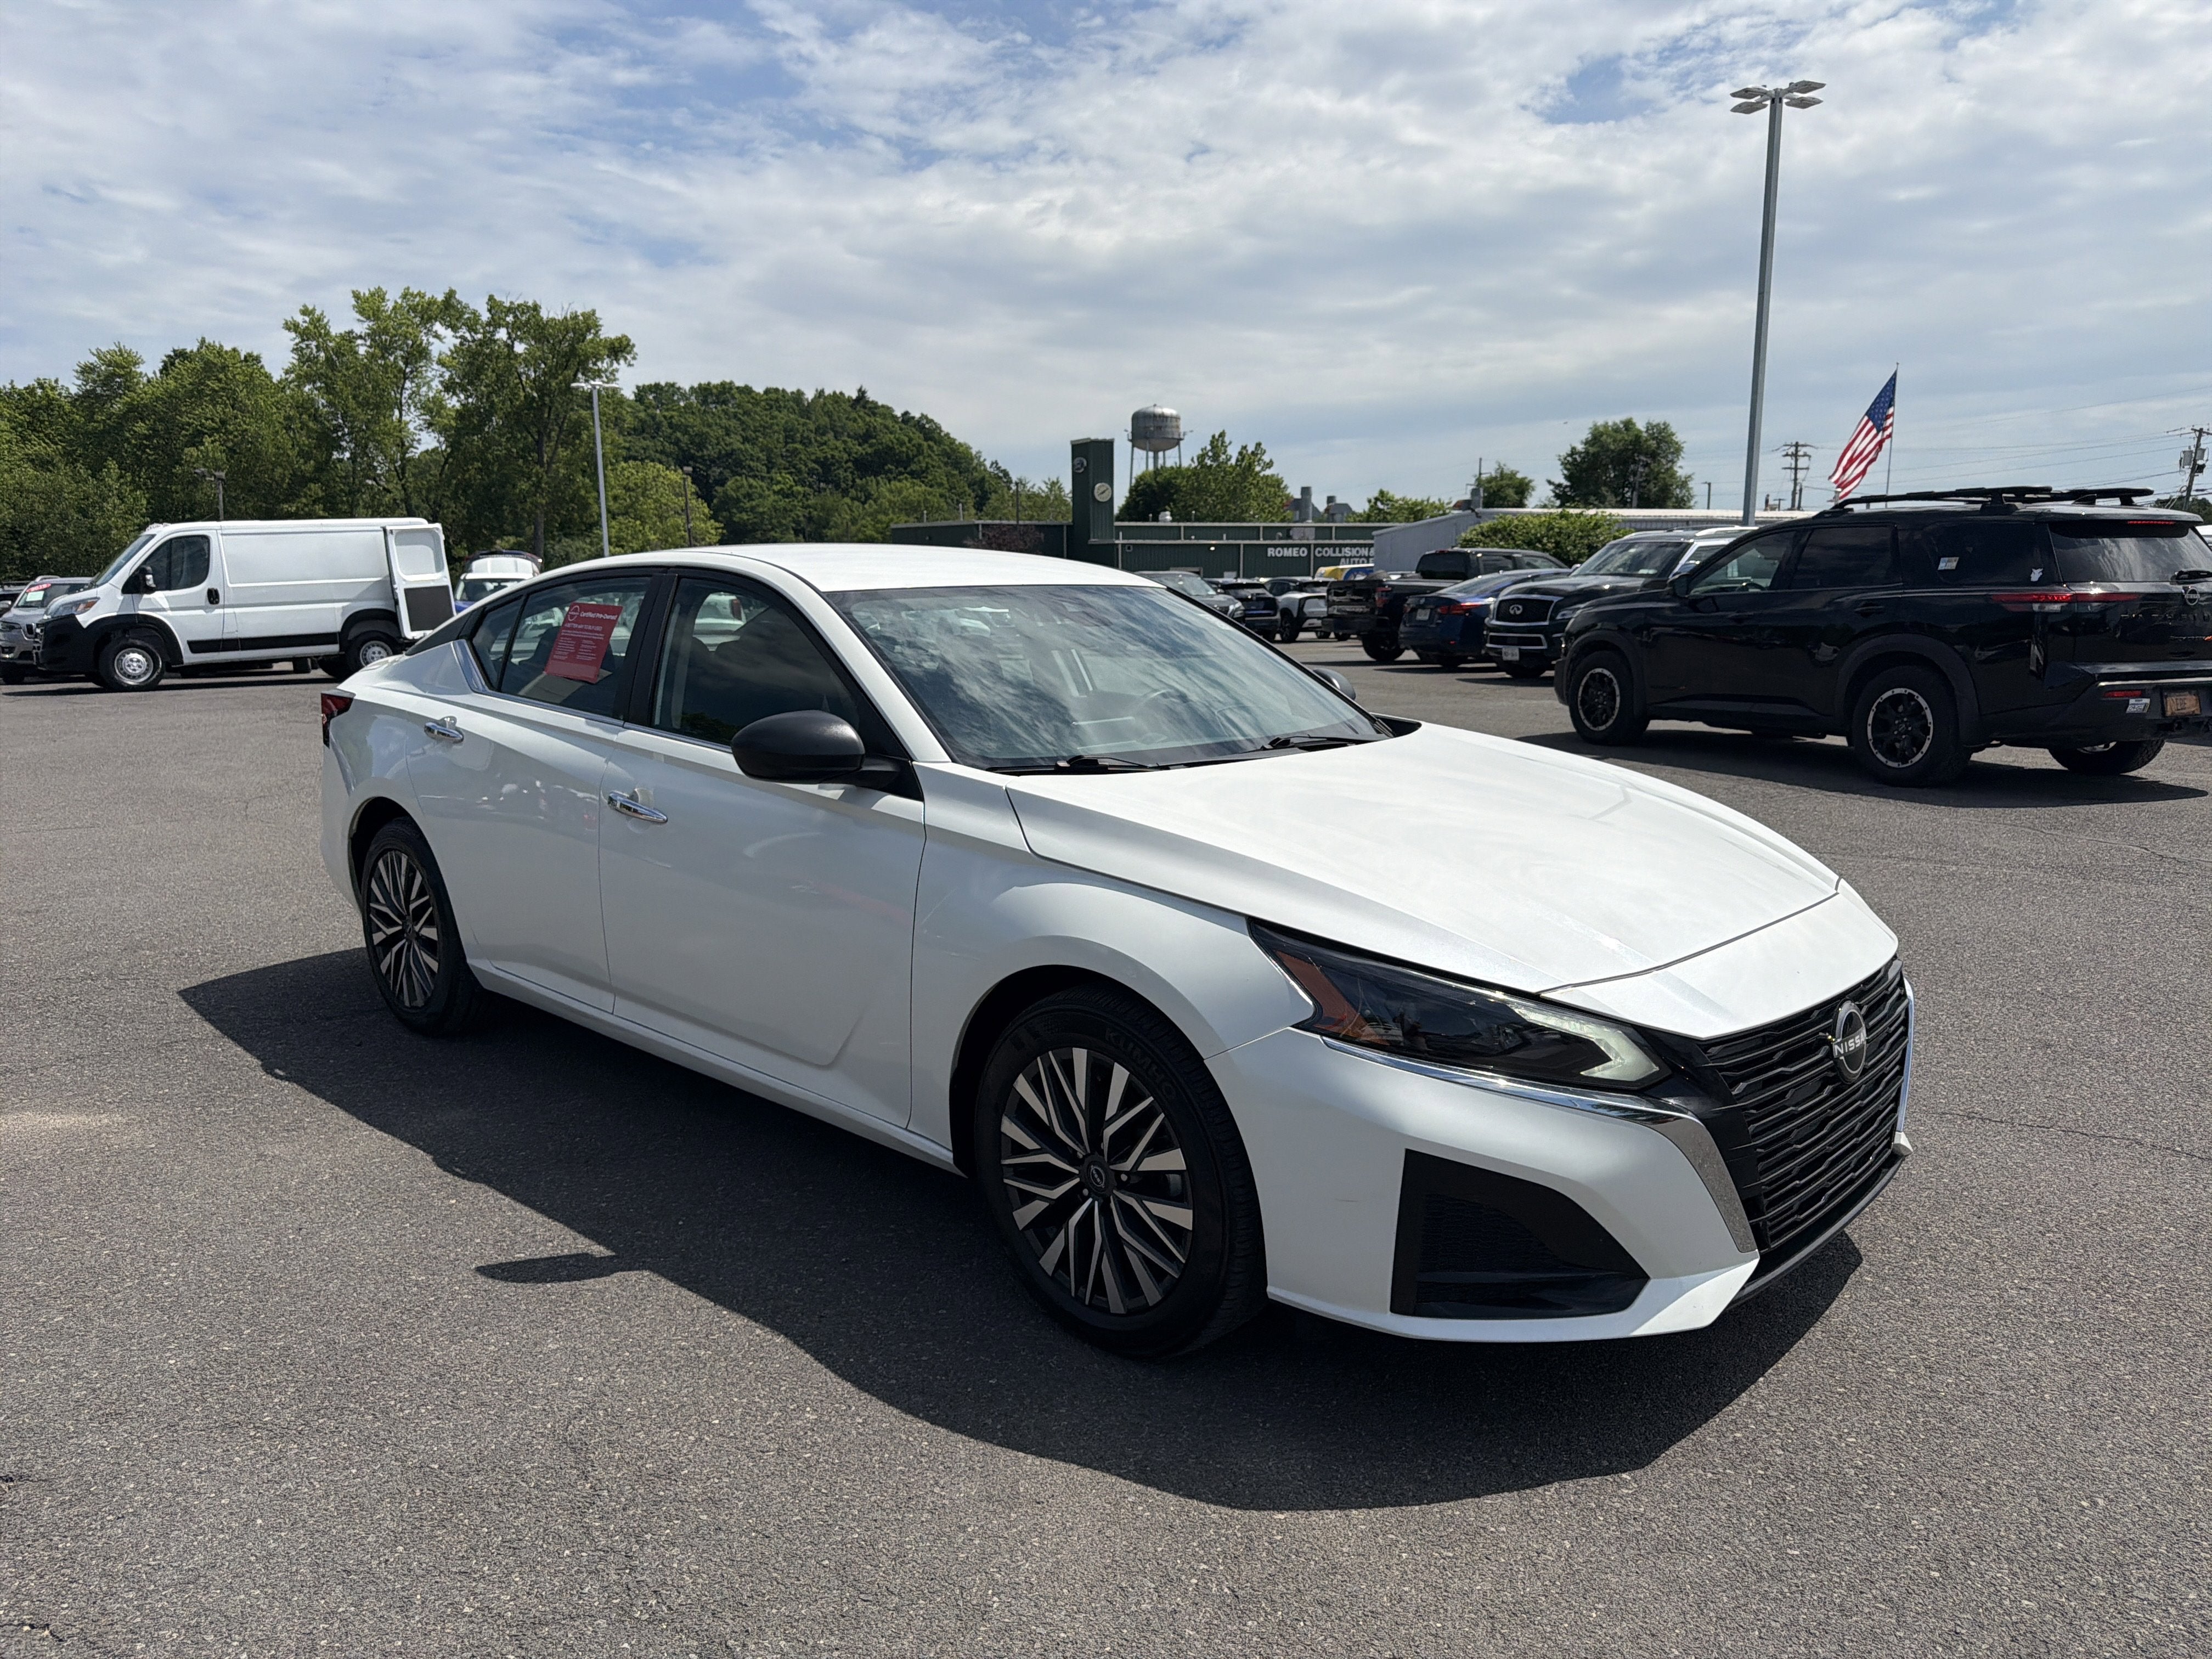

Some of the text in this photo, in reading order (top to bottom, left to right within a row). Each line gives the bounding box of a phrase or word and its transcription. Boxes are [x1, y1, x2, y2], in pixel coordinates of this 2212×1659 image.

[1267, 547, 1307, 557] ROMEO
[1315, 547, 1368, 557] COLLISION
[1834, 1032, 1865, 1056] NISSA
